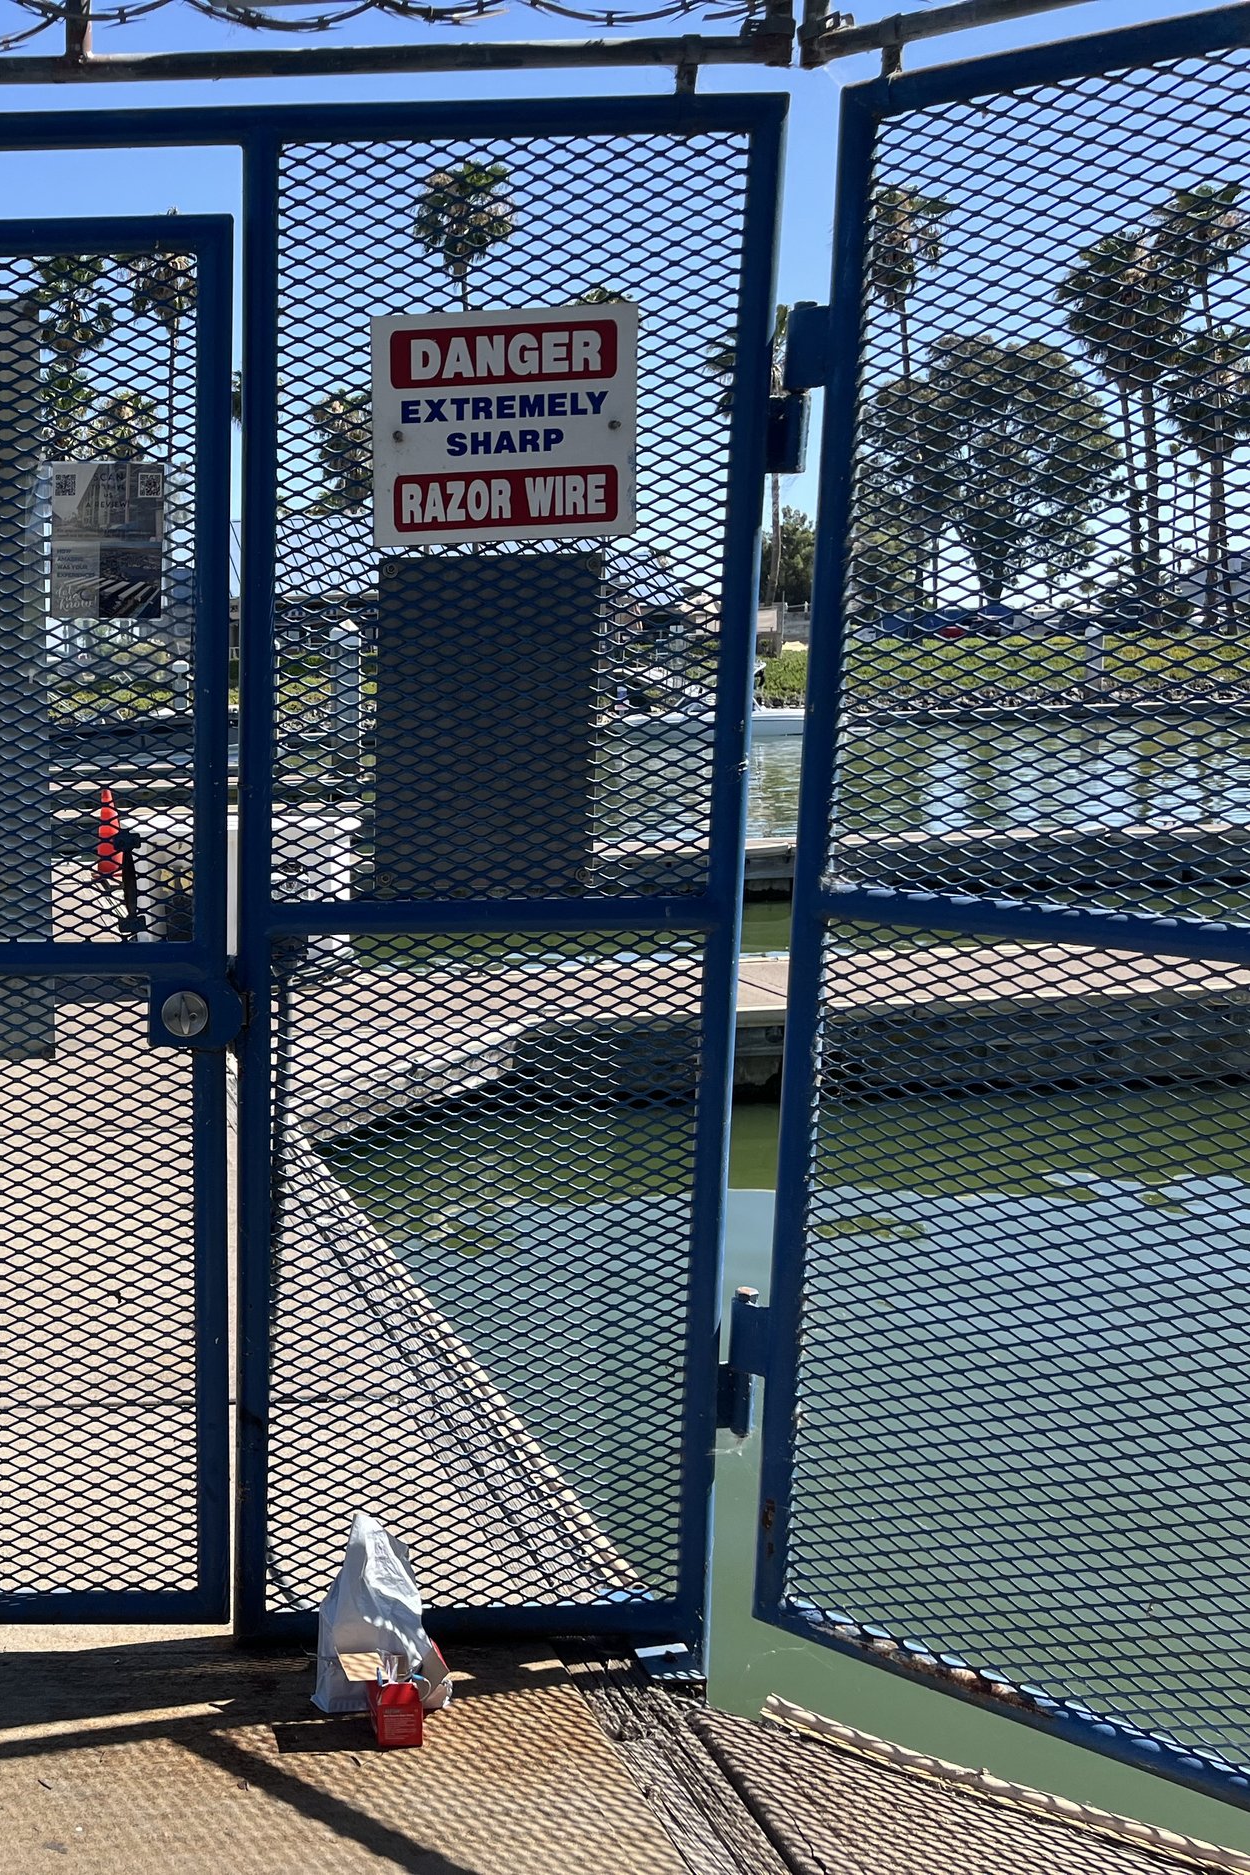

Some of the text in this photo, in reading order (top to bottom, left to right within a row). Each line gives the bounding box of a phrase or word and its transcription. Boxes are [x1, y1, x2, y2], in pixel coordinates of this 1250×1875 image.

[410, 330, 601, 381] DANGER
[401, 391, 609, 424] EXTREMELY
[446, 428, 564, 456] SHARP
[401, 473, 607, 524] RAZOR WIRE
